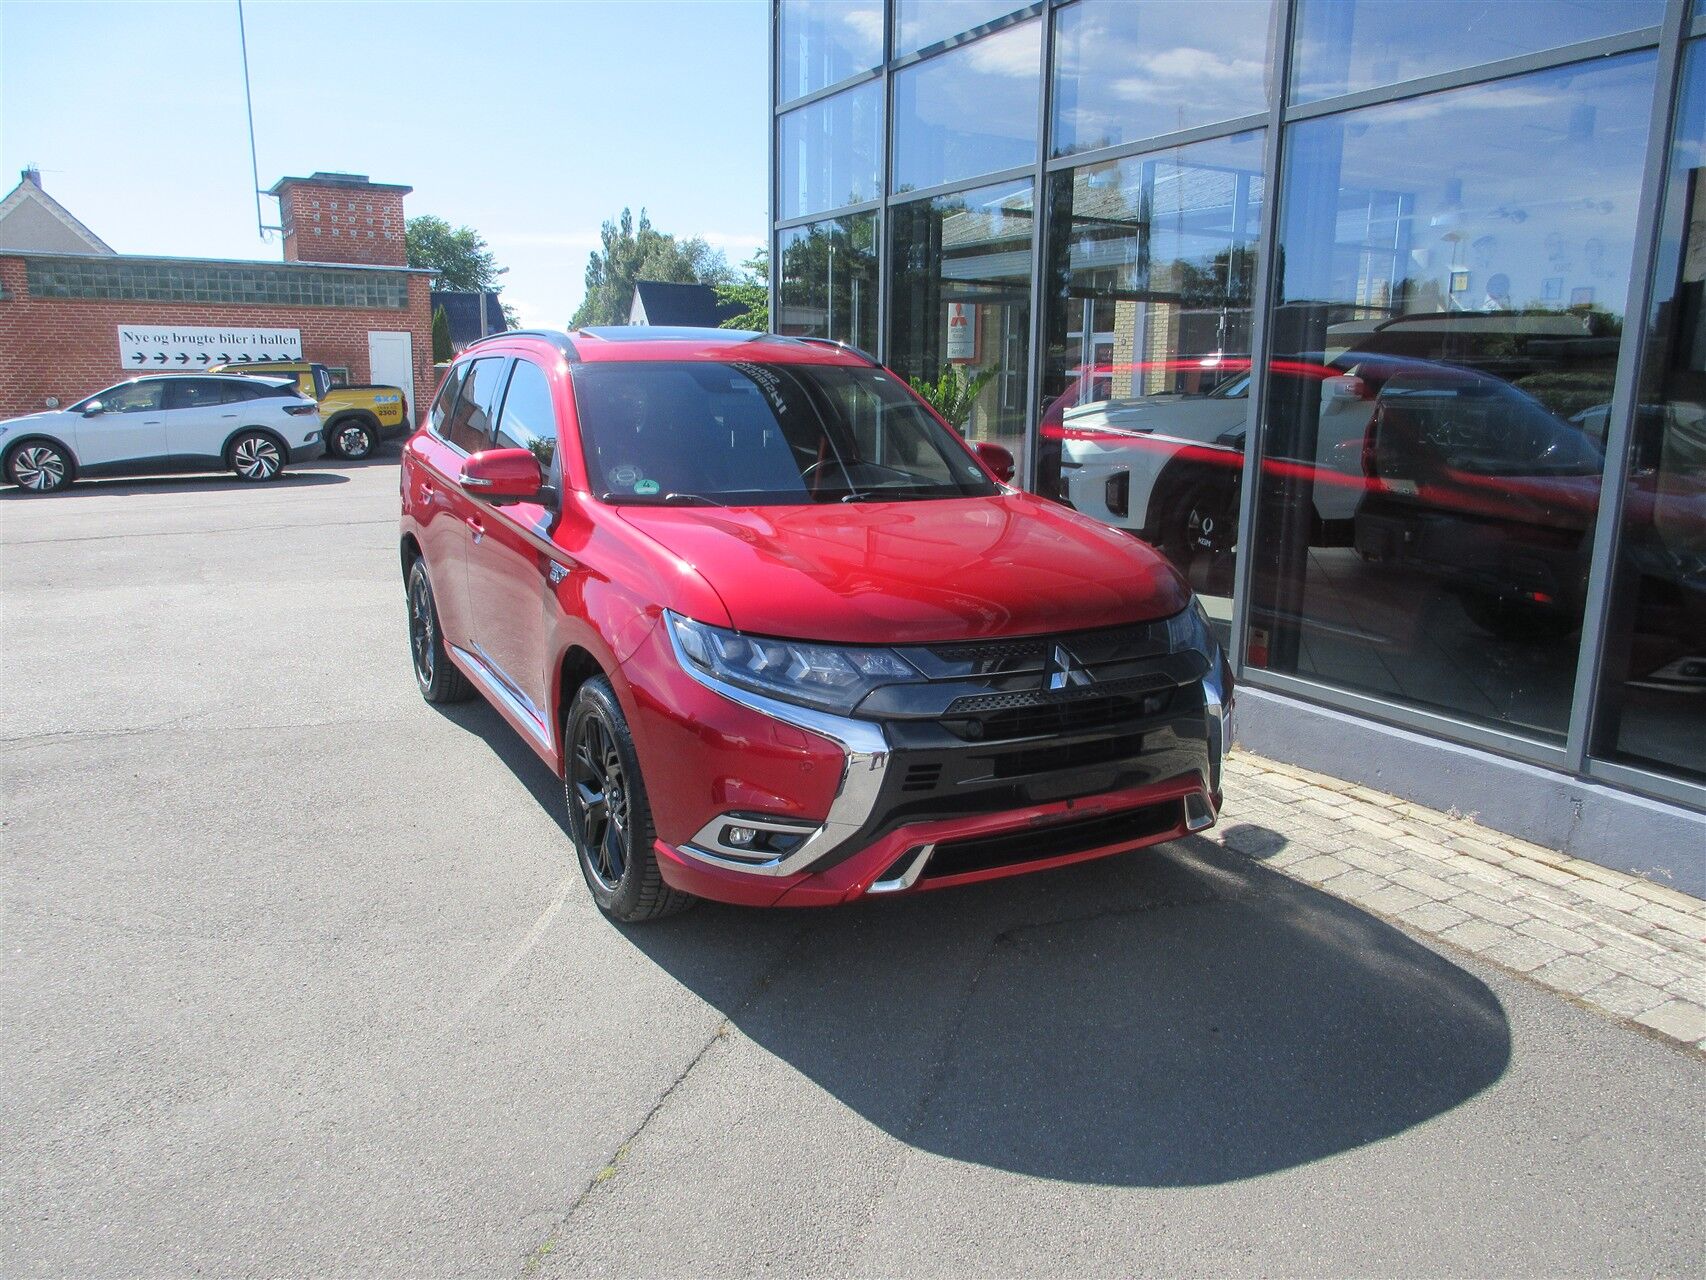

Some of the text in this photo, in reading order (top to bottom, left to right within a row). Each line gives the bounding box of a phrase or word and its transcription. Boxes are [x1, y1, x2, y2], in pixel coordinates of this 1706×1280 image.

[124, 332, 297, 346] Nye og brugte biler i hallen
